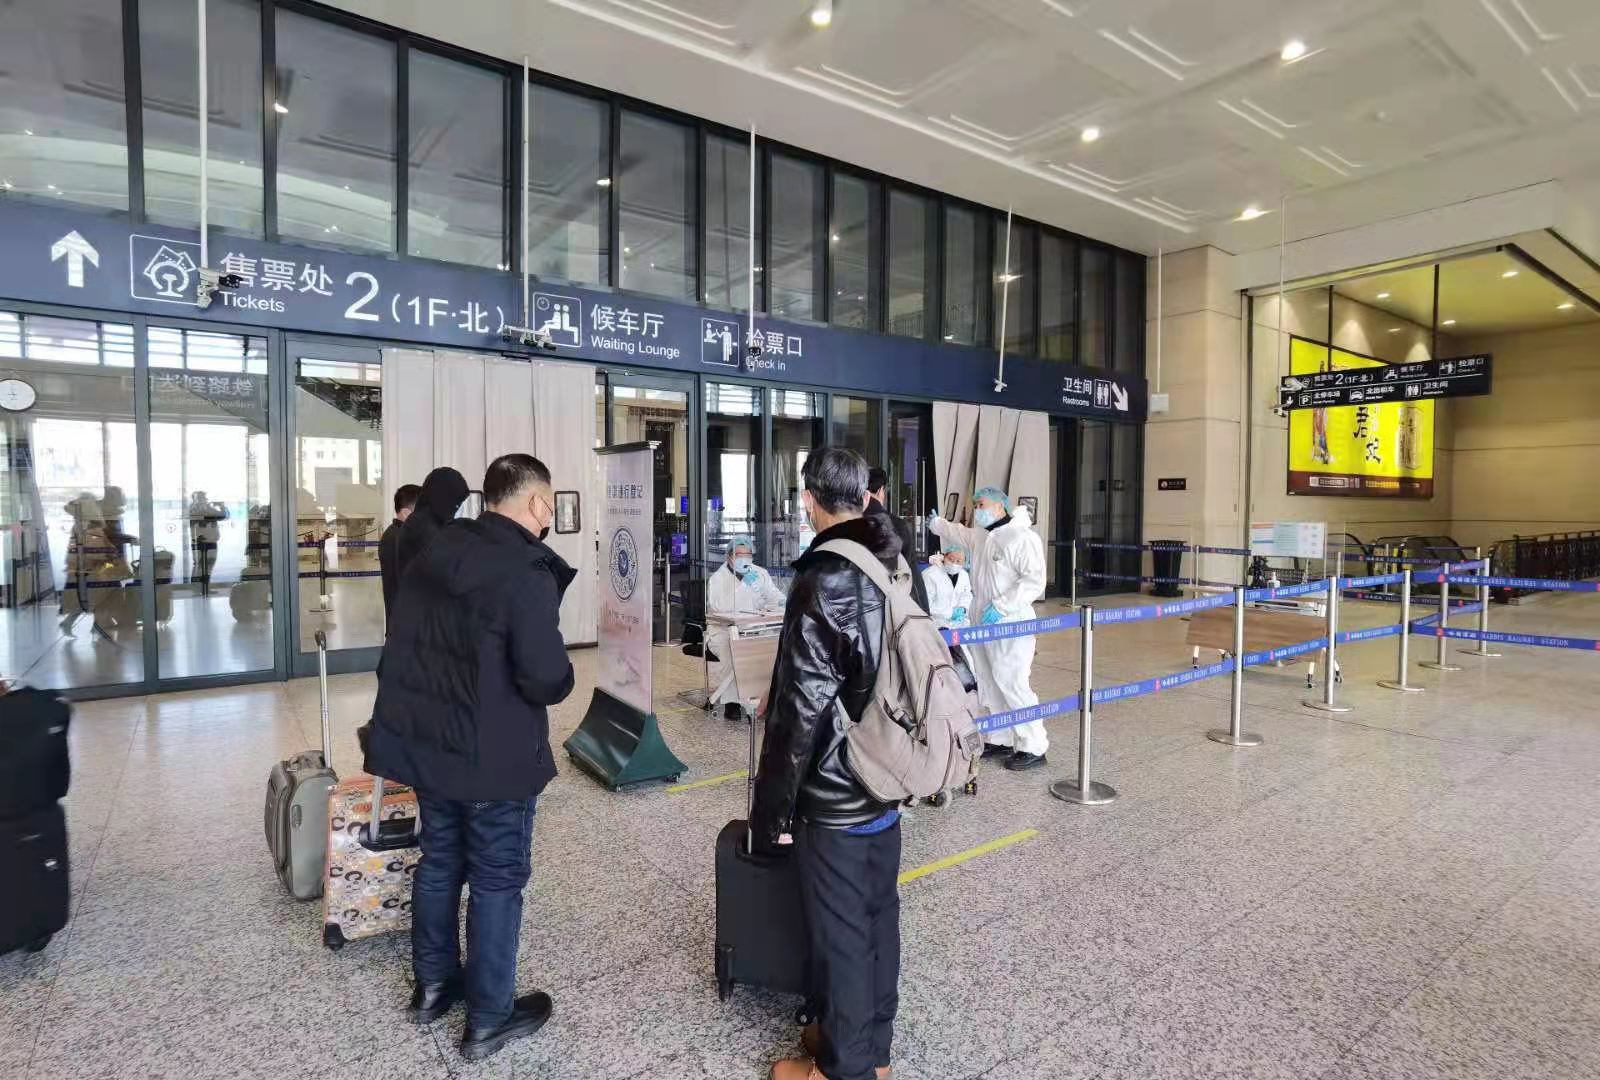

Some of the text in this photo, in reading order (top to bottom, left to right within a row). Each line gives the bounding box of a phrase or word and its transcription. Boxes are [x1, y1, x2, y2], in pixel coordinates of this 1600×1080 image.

[220, 252, 333, 296] 售票处
[219, 290, 285, 312] Tickets
[344, 271, 380, 322] 2
[590, 303, 665, 339] 候车厅
[590, 334, 680, 359] Waiting Lounge
[777, 360, 786, 371] in
[1063, 377, 1092, 395] 卫生间
